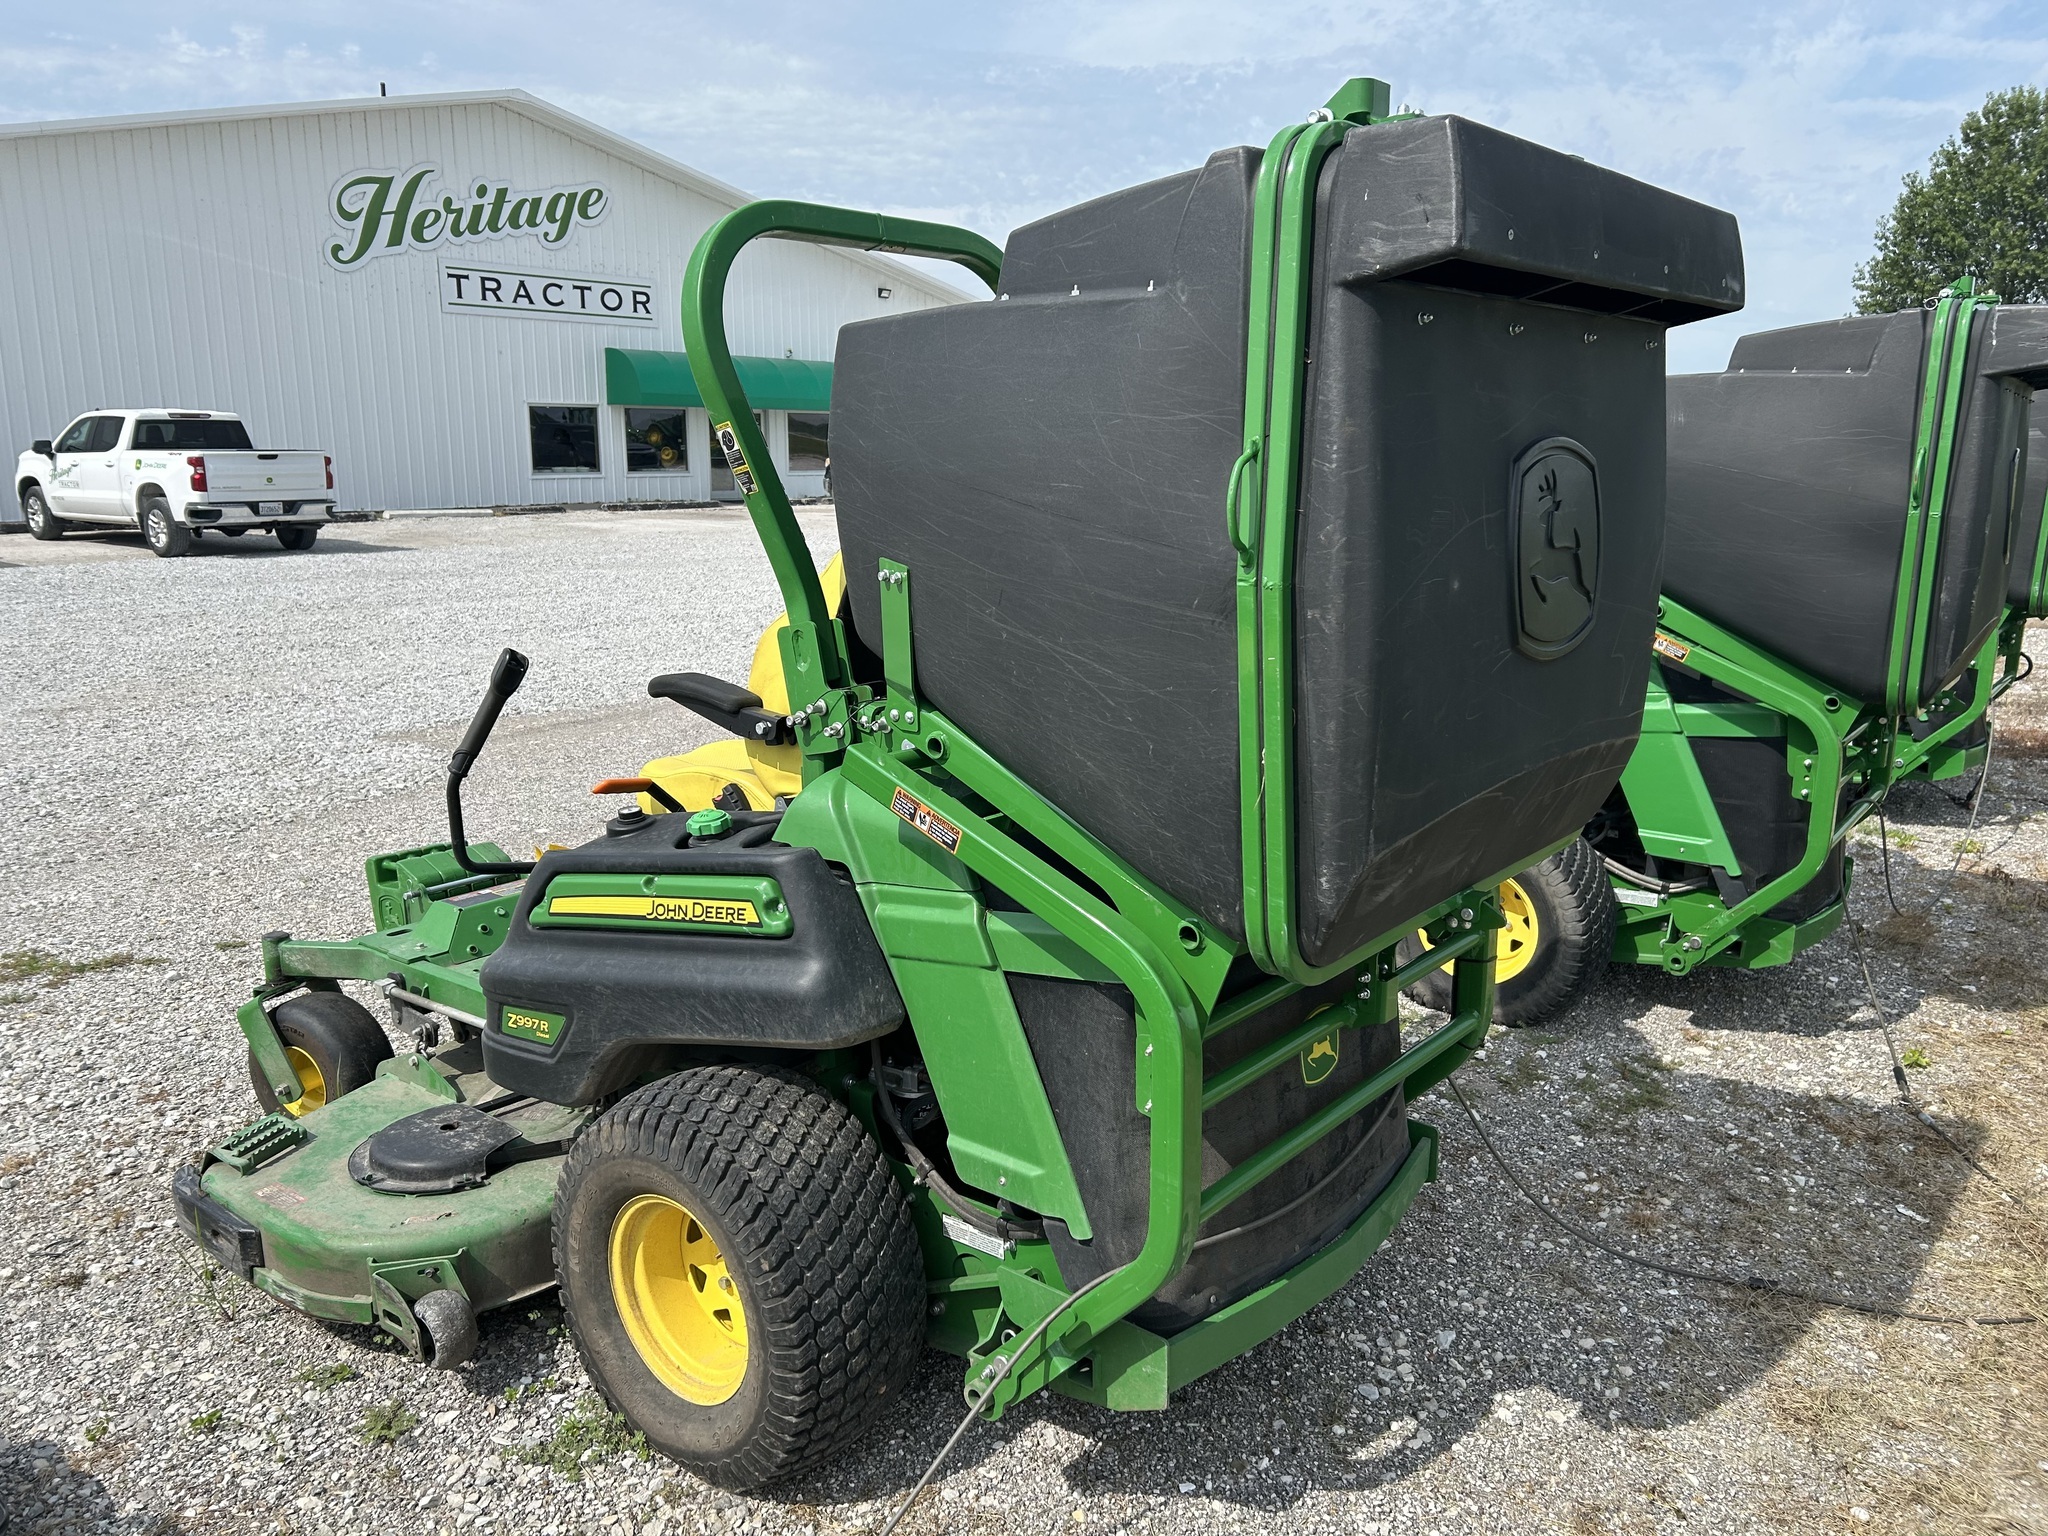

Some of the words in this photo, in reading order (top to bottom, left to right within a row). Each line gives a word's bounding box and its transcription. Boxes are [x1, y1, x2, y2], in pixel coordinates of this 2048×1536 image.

[330, 169, 608, 265] Heritage
[446, 271, 651, 315] TRACTOR
[646, 900, 688, 918] JOHN
[692, 902, 747, 921] DEERE
